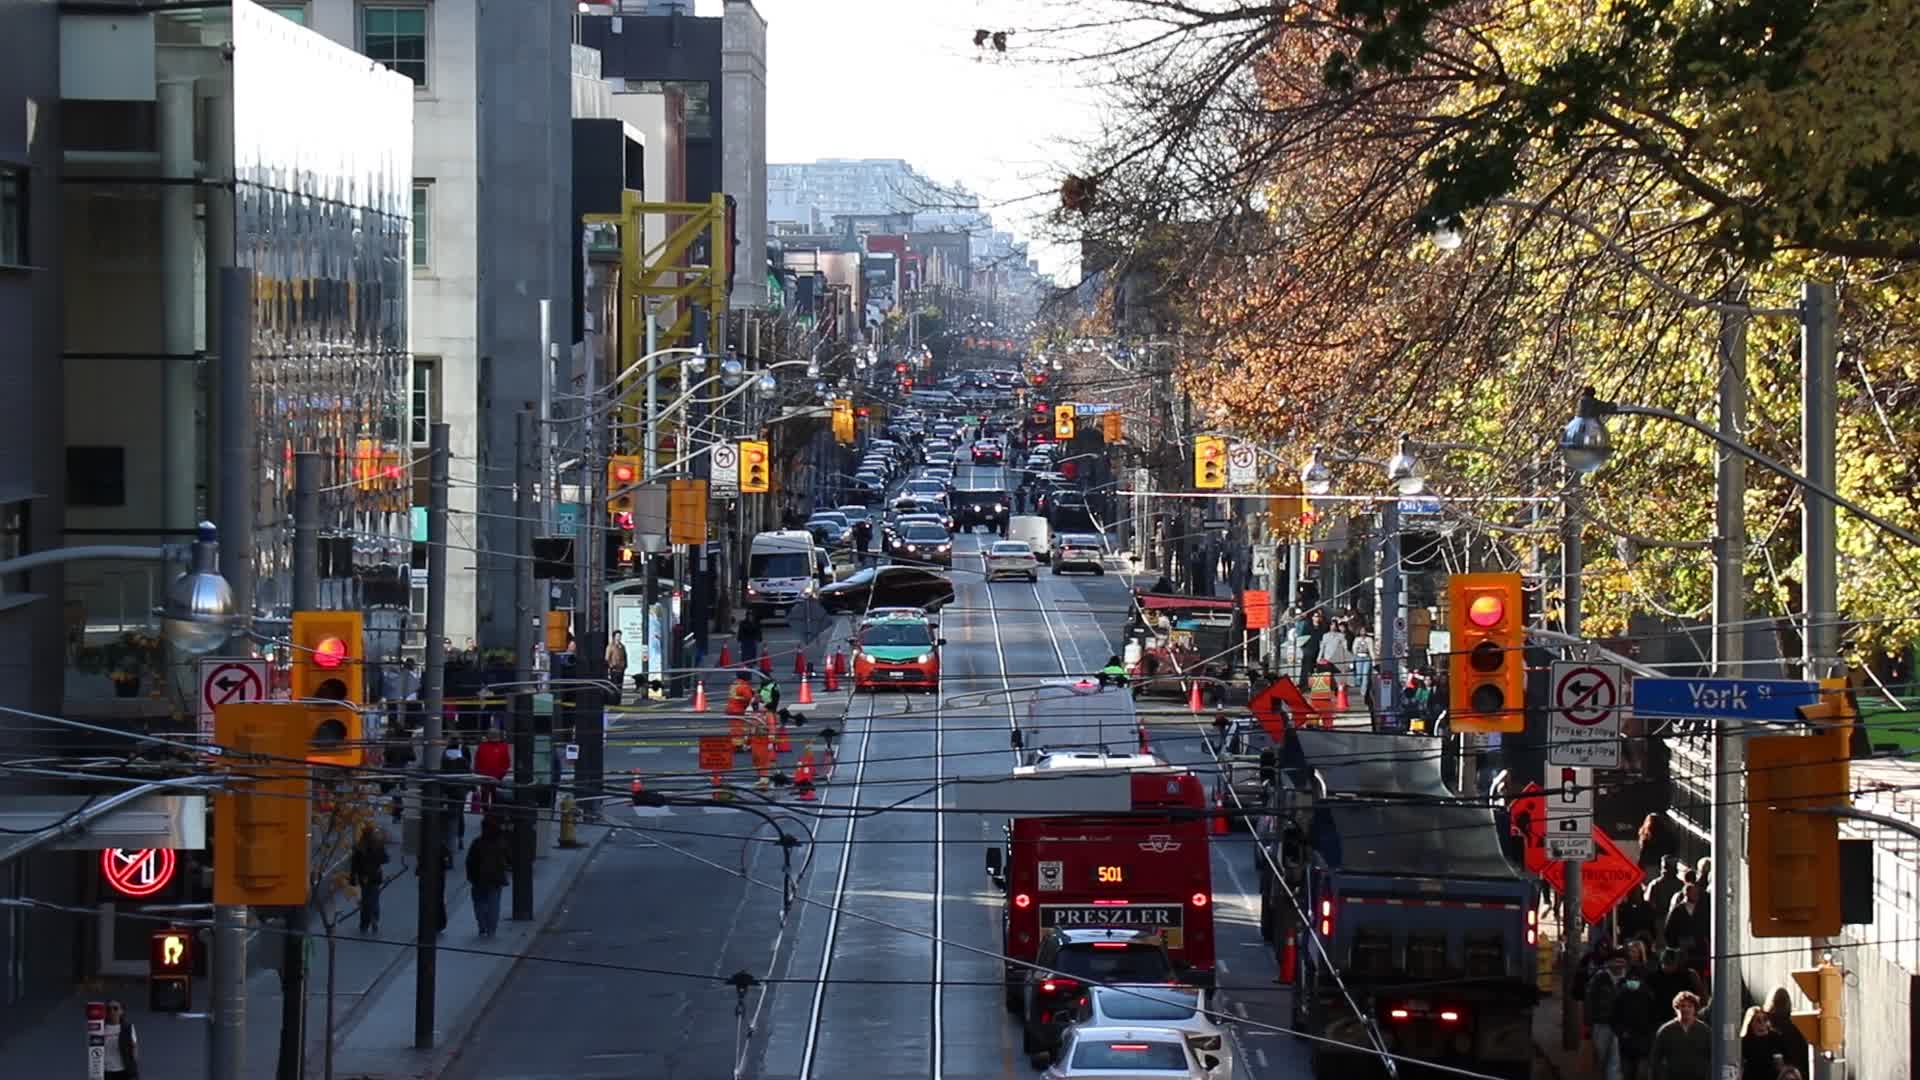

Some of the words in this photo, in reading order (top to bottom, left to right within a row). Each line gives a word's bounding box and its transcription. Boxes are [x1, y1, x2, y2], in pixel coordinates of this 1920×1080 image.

[1687, 682, 1748, 709] York
[1758, 685, 1773, 699] St
[1567, 839, 1589, 847] LIGHT
[1098, 866, 1123, 882] 501
[1552, 870, 1633, 881] CTRUCTION
[1054, 909, 1170, 924] PRESZLER
